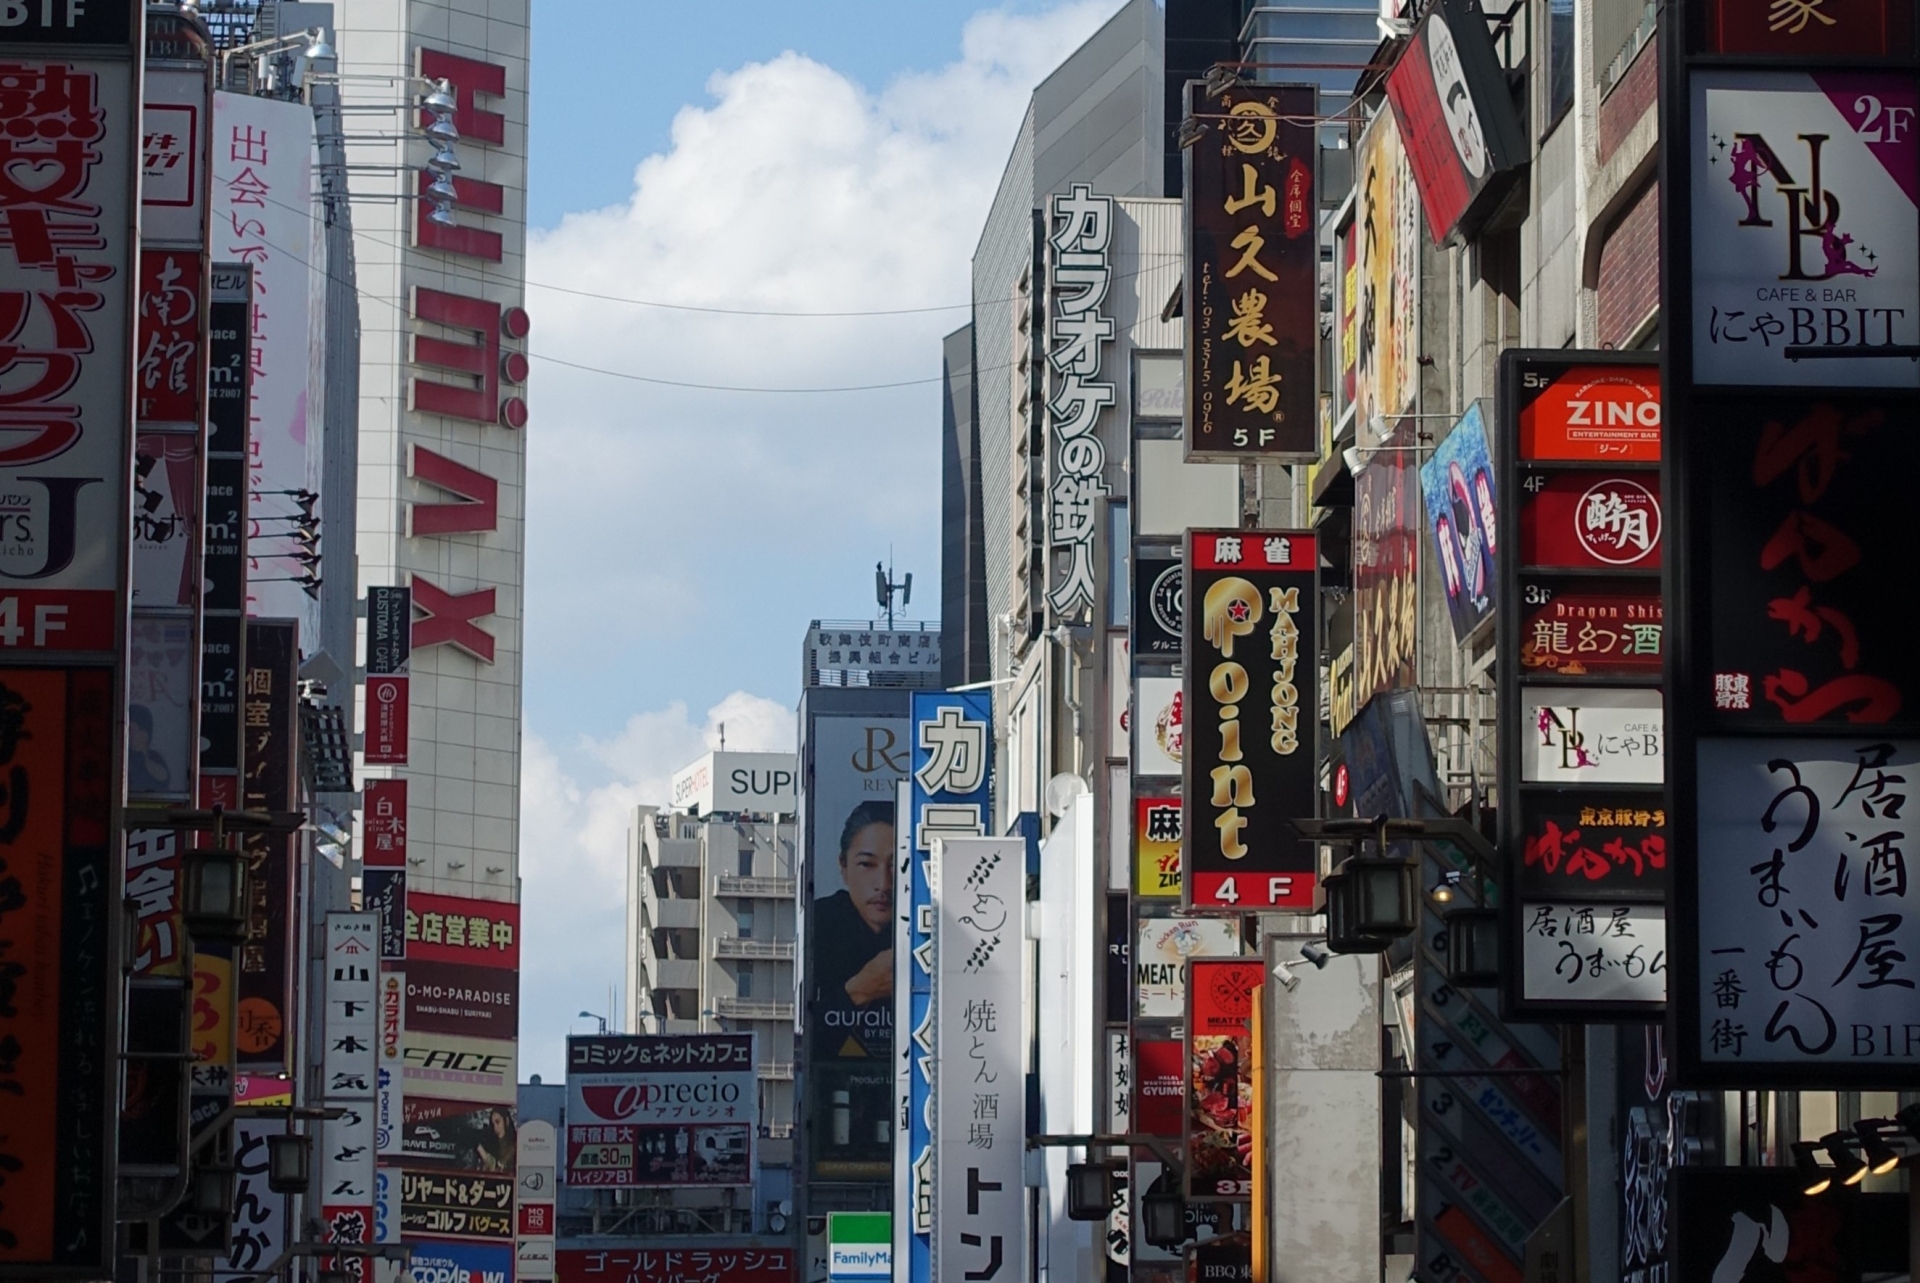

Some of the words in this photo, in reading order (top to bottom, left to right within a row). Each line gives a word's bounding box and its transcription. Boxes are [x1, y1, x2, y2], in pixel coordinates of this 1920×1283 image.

[1853, 95, 1915, 144] 2F
[1219, 163, 1280, 413] 山久農場
[1756, 287, 1800, 302] CAFE
[1804, 287, 1817, 302] &
[1822, 288, 1857, 302] BAR
[1523, 372, 1549, 388] 5F
[1566, 400, 1661, 427] ZINO
[1572, 431, 1638, 439] ENTERTAINMENT
[1523, 476, 1545, 493] 4F
[1586, 491, 1650, 551] 酔月
[1213, 537, 1292, 565] 麻雀
[1525, 584, 1551, 604] 3F
[0, 597, 69, 647] 4F
[376, 588, 389, 641] CUSTOMA
[1557, 604, 1618, 618] Dragon
[375, 647, 388, 673] CAFE
[1268, 587, 1300, 756] MAHJONG
[1203, 576, 1264, 861] Point
[1624, 723, 1648, 733] CAFE
[730, 769, 797, 796] SUP
[374, 797, 405, 851] 白木屋
[1831, 742, 1916, 991] 居酒屋
[383, 884, 394, 955] インターネット
[1749, 758, 1838, 1056] うまいもん
[1156, 925, 1179, 950] Chicken
[1178, 920, 1198, 931] Run
[1526, 906, 1637, 939] 居酒屋
[1138, 963, 1176, 985] MEAT
[1140, 988, 1184, 1000] ミート
[1708, 947, 1749, 1057] 一番街
[384, 989, 400, 1046] カラオケ
[416, 1005, 460, 1017] SHABU-SHABU
[864, 1028, 877, 1039] BY
[573, 1043, 748, 1065] コミック&ネットカフェ
[961, 998, 1001, 1150] 焼とん酒場
[381, 1091, 389, 1126] POKER
[402, 1139, 427, 1151] RAVE
[429, 1142, 456, 1151] POINT
[572, 1126, 634, 1144] 新宿最大
[225, 1131, 274, 1283] とんか
[426, 1210, 467, 1232] ゴルフ
[469, 1215, 511, 1235] バグース
[585, 1252, 788, 1273] ゴールドラッシュ
[1204, 1264, 1236, 1278] BBQ
